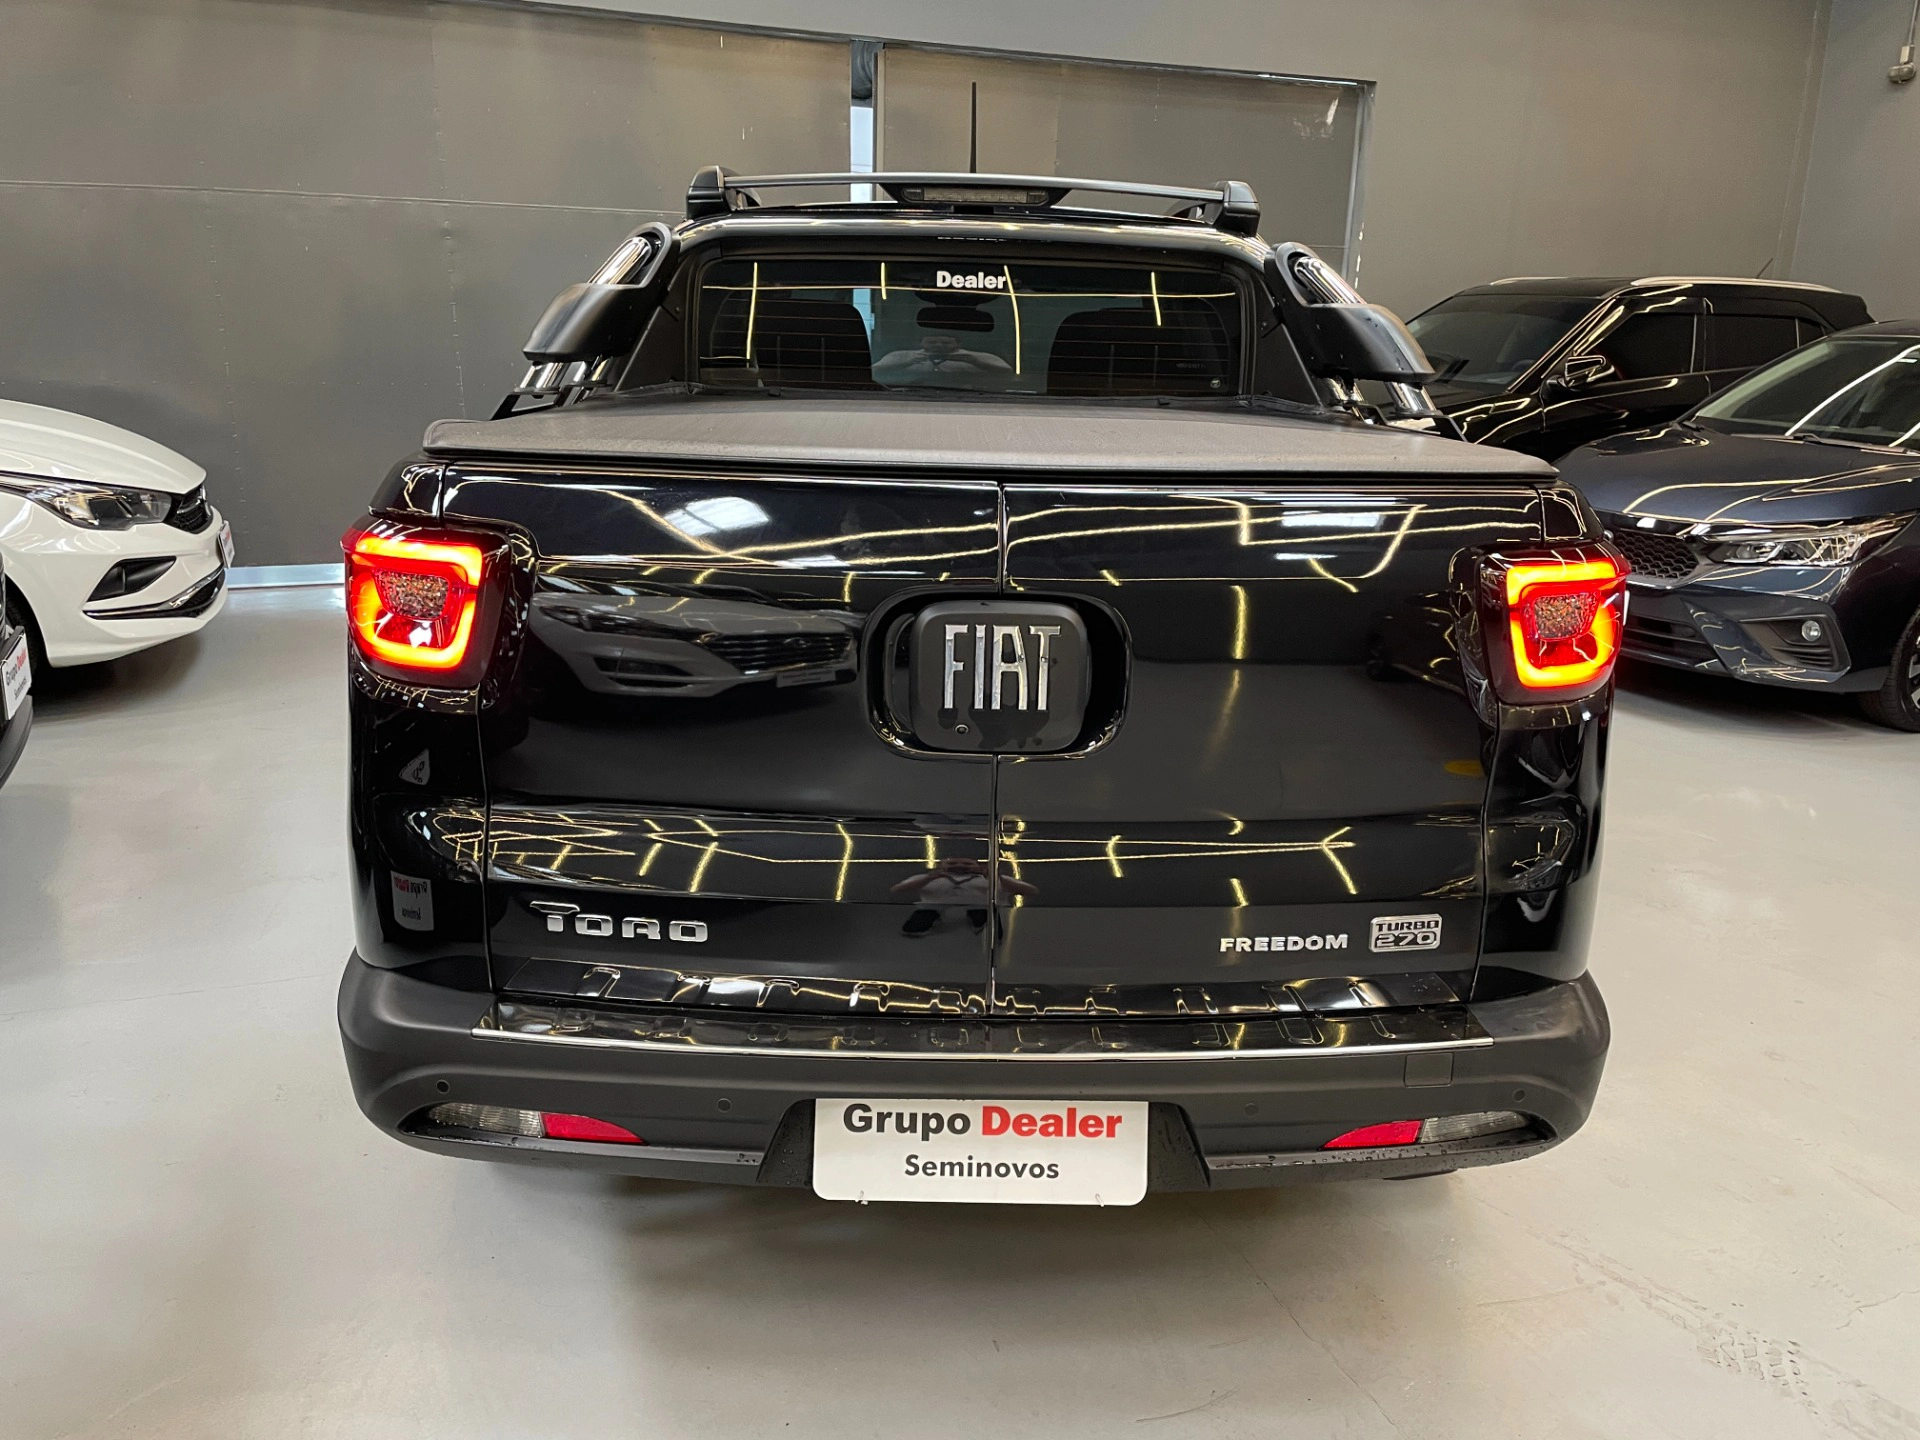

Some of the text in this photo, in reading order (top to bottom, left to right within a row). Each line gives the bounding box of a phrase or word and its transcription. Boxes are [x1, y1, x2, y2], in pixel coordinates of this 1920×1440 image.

[937, 271, 1006, 289] Dealer
[944, 624, 1061, 710] FIAT
[529, 900, 708, 943] TORO
[1376, 920, 1439, 932] TURBO
[1219, 934, 1348, 952] FREEDOM
[1376, 931, 1437, 948] 270
[843, 1103, 1122, 1141] Grupo Dealer
[904, 1154, 1059, 1179] Seminovos
